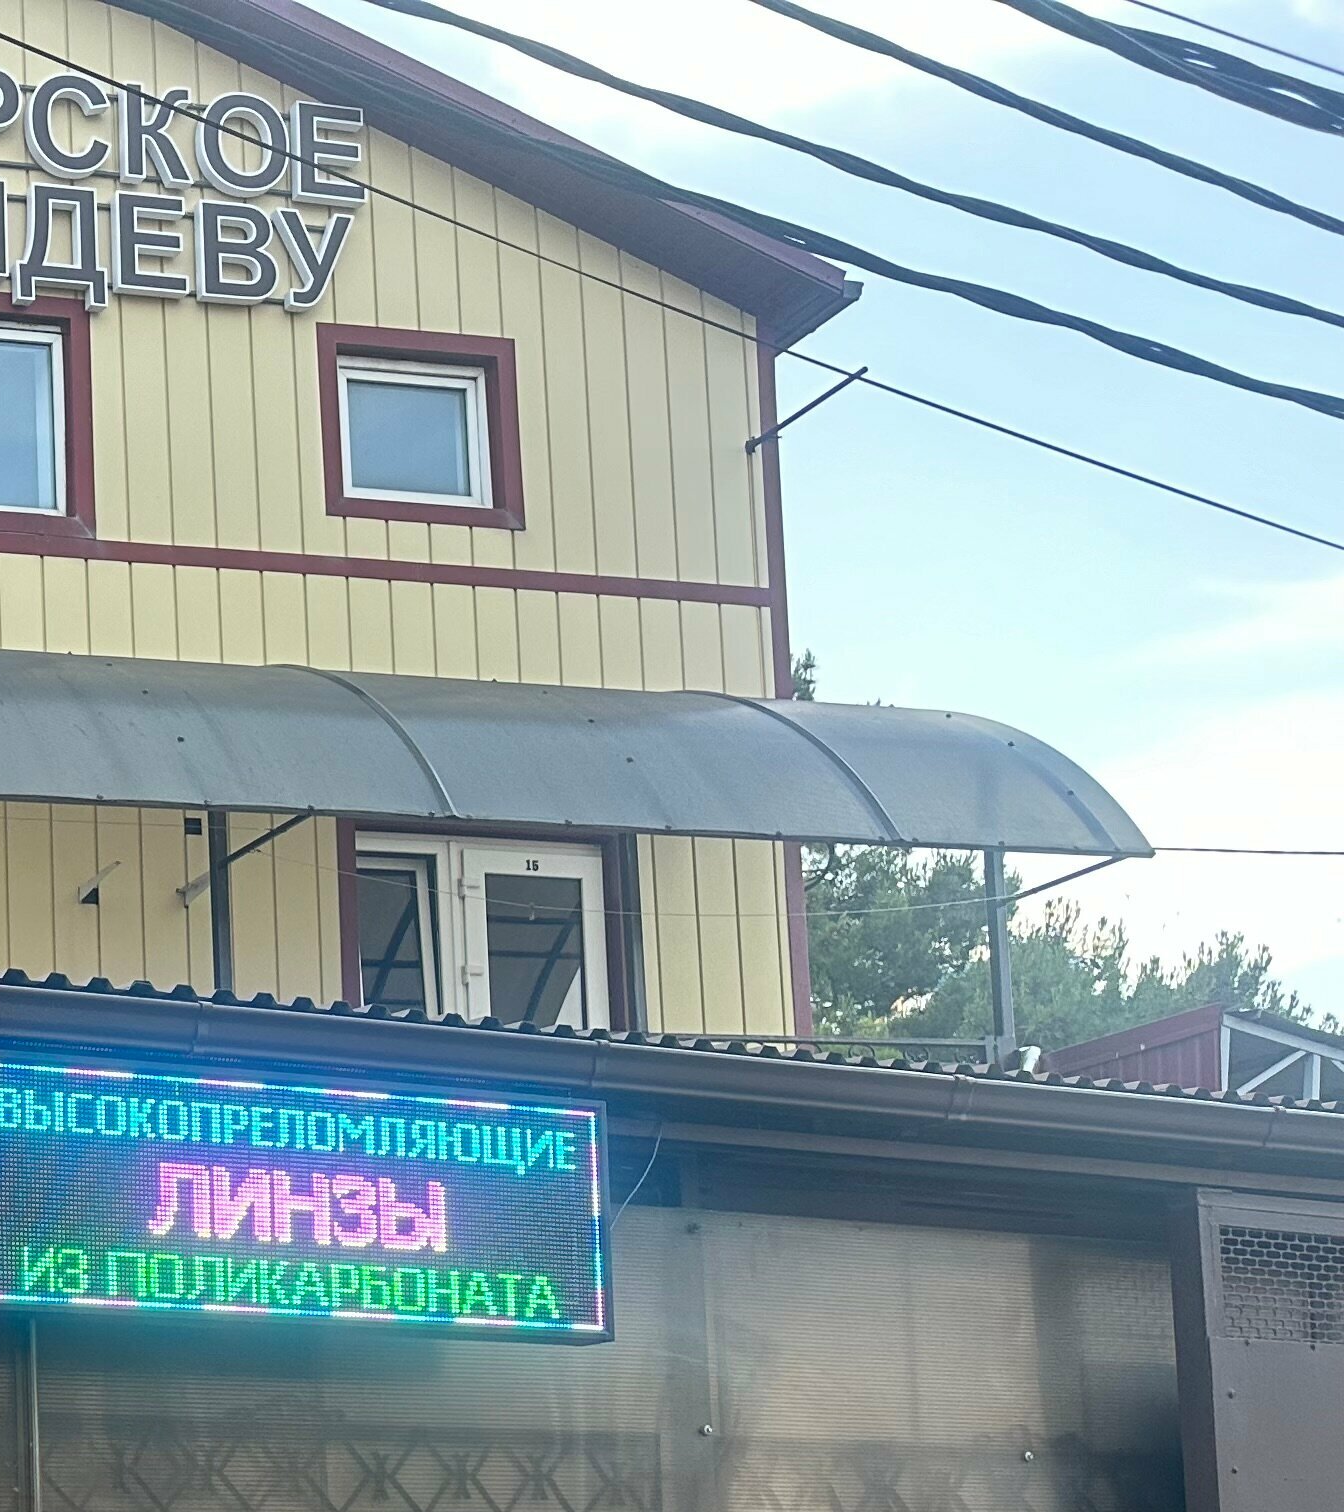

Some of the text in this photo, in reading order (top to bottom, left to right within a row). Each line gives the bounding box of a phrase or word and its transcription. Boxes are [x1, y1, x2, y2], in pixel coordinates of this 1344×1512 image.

[148, 1161, 450, 1253] ЛИНЗЫ
[20, 1245, 562, 1319] ИЗ ПОЛИКАРБОНАТА
